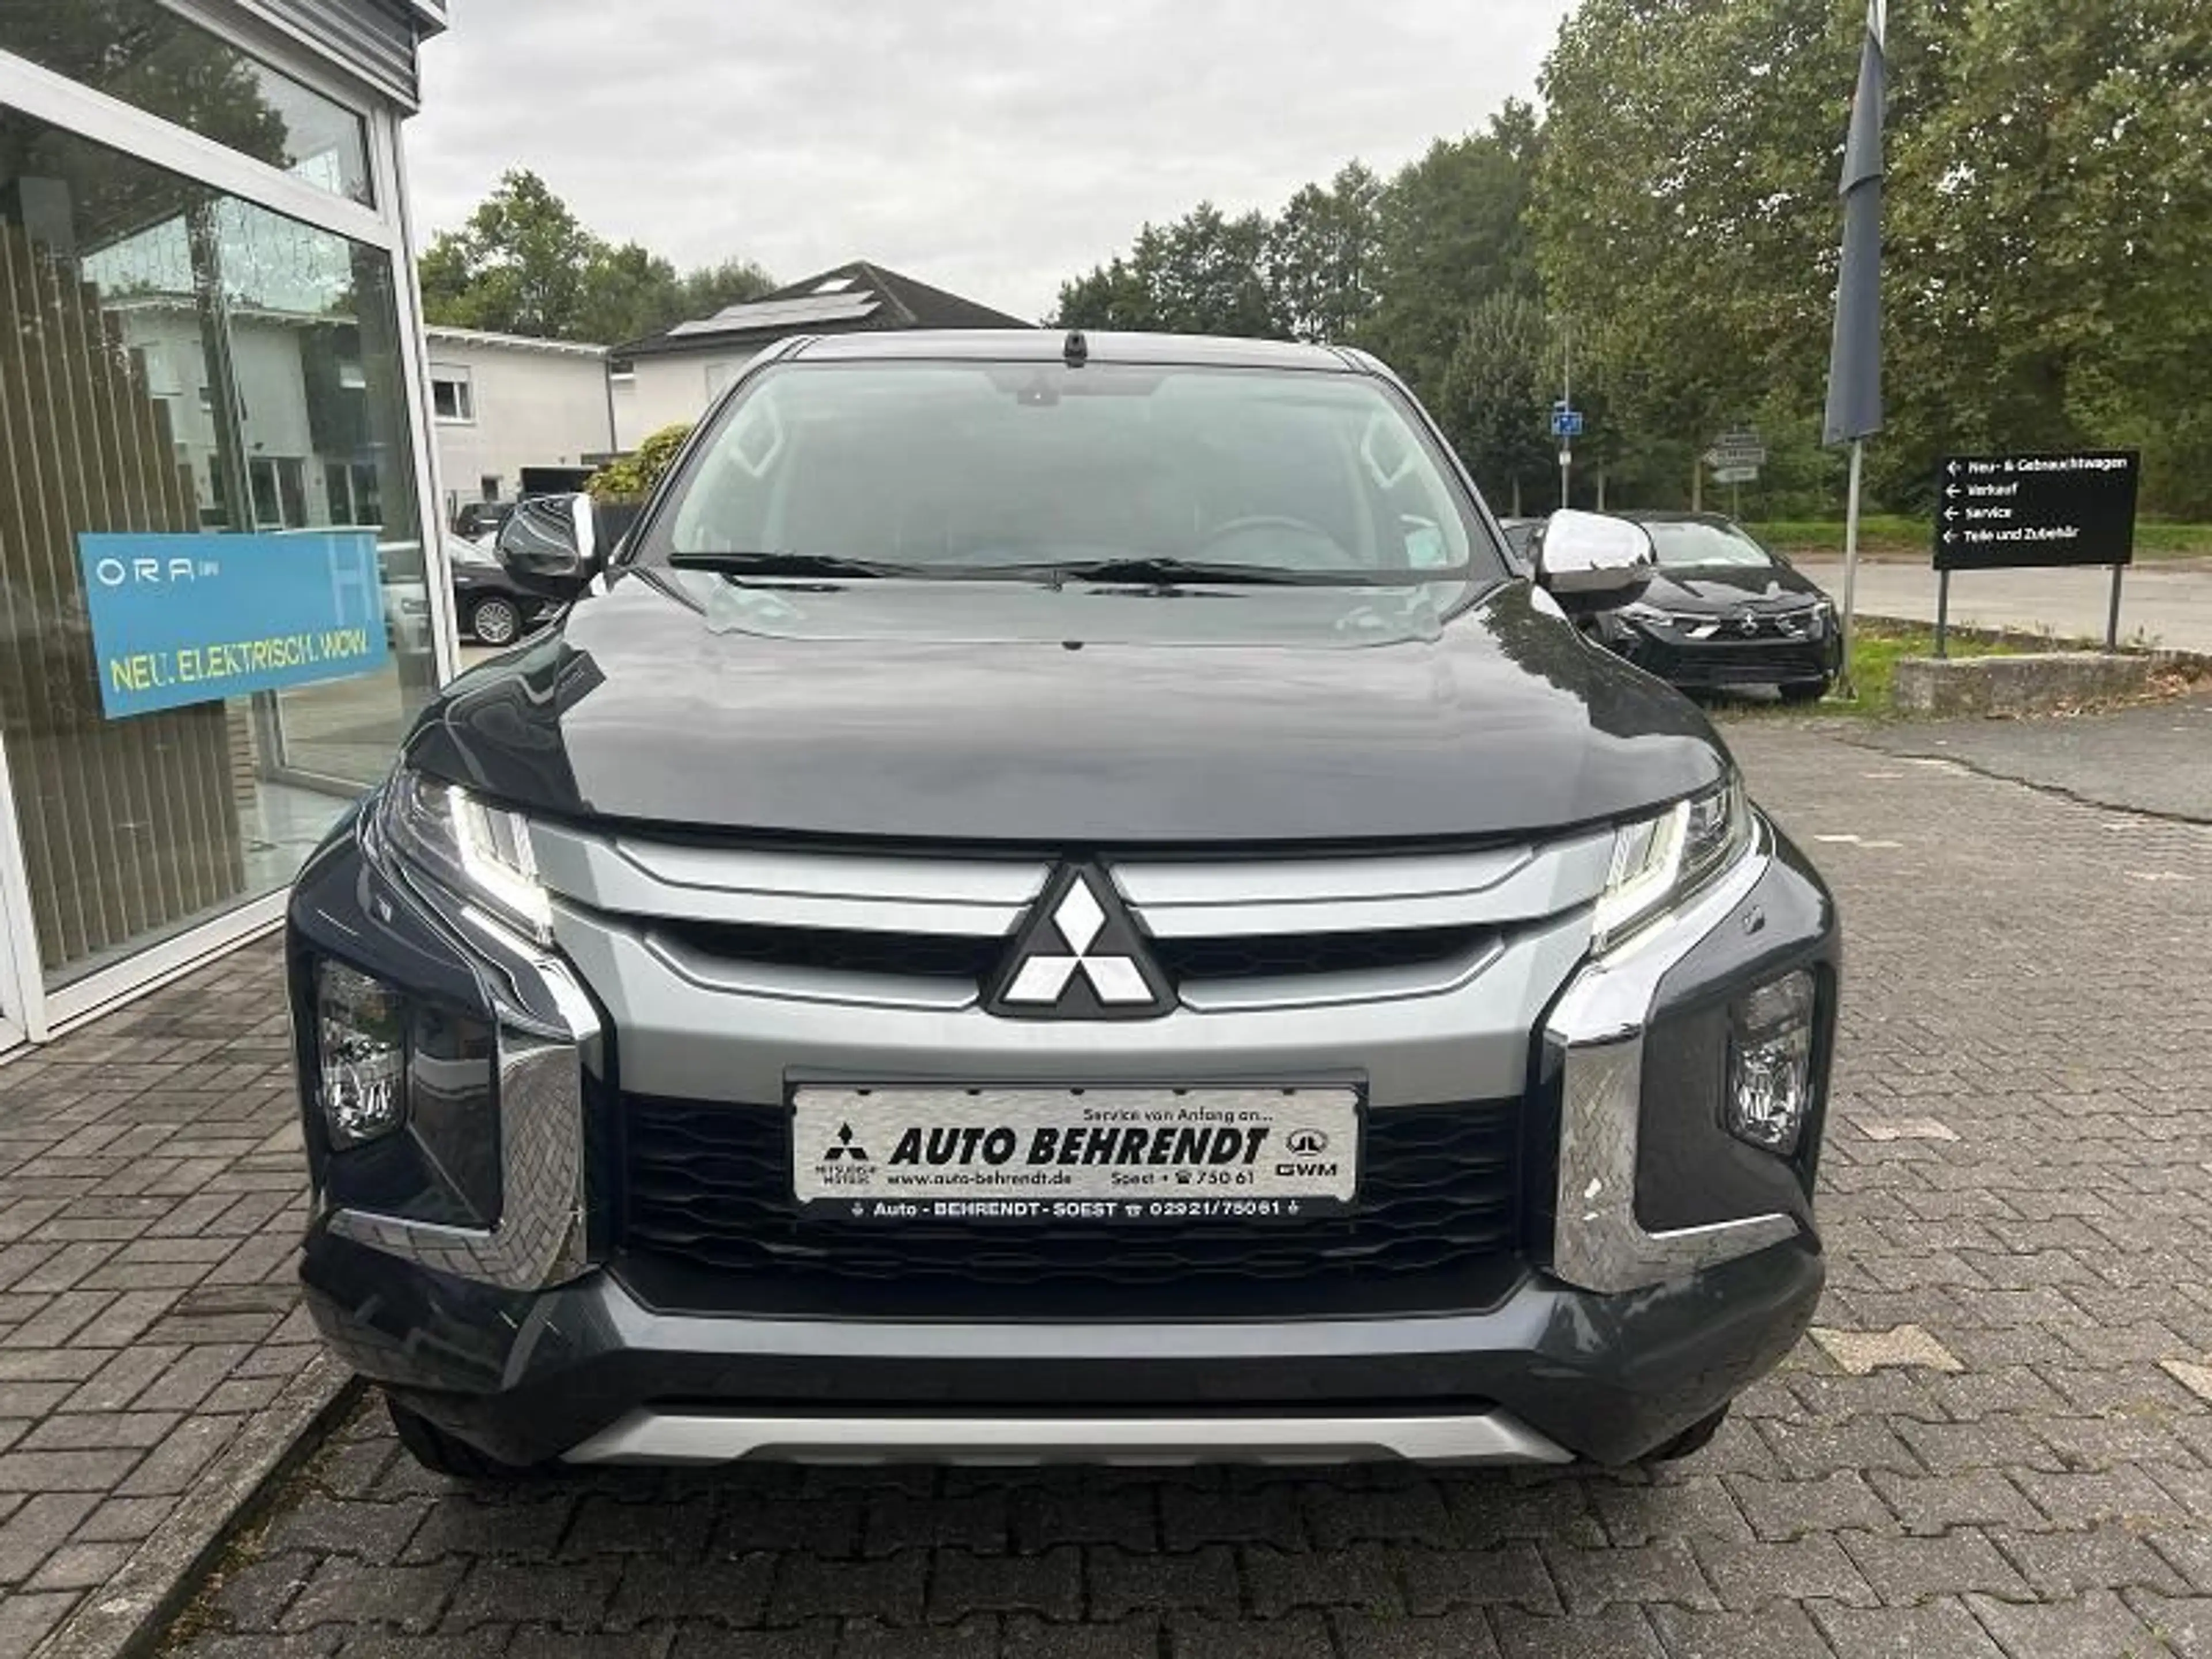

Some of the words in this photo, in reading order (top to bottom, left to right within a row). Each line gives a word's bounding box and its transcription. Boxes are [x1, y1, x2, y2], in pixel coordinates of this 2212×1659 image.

[1996, 528, 2022, 540] und
[96, 558, 195, 586] ORA
[1146, 1111, 1172, 1120] von
[1177, 1108, 1234, 1124] Anfang
[888, 1126, 1017, 1165] AUTO
[1026, 1127, 1270, 1165] BEHRENDT
[888, 1169, 1071, 1185] www.auto-behrendt.de
[1275, 1163, 1337, 1176] GWM
[874, 1202, 917, 1217] Auto
